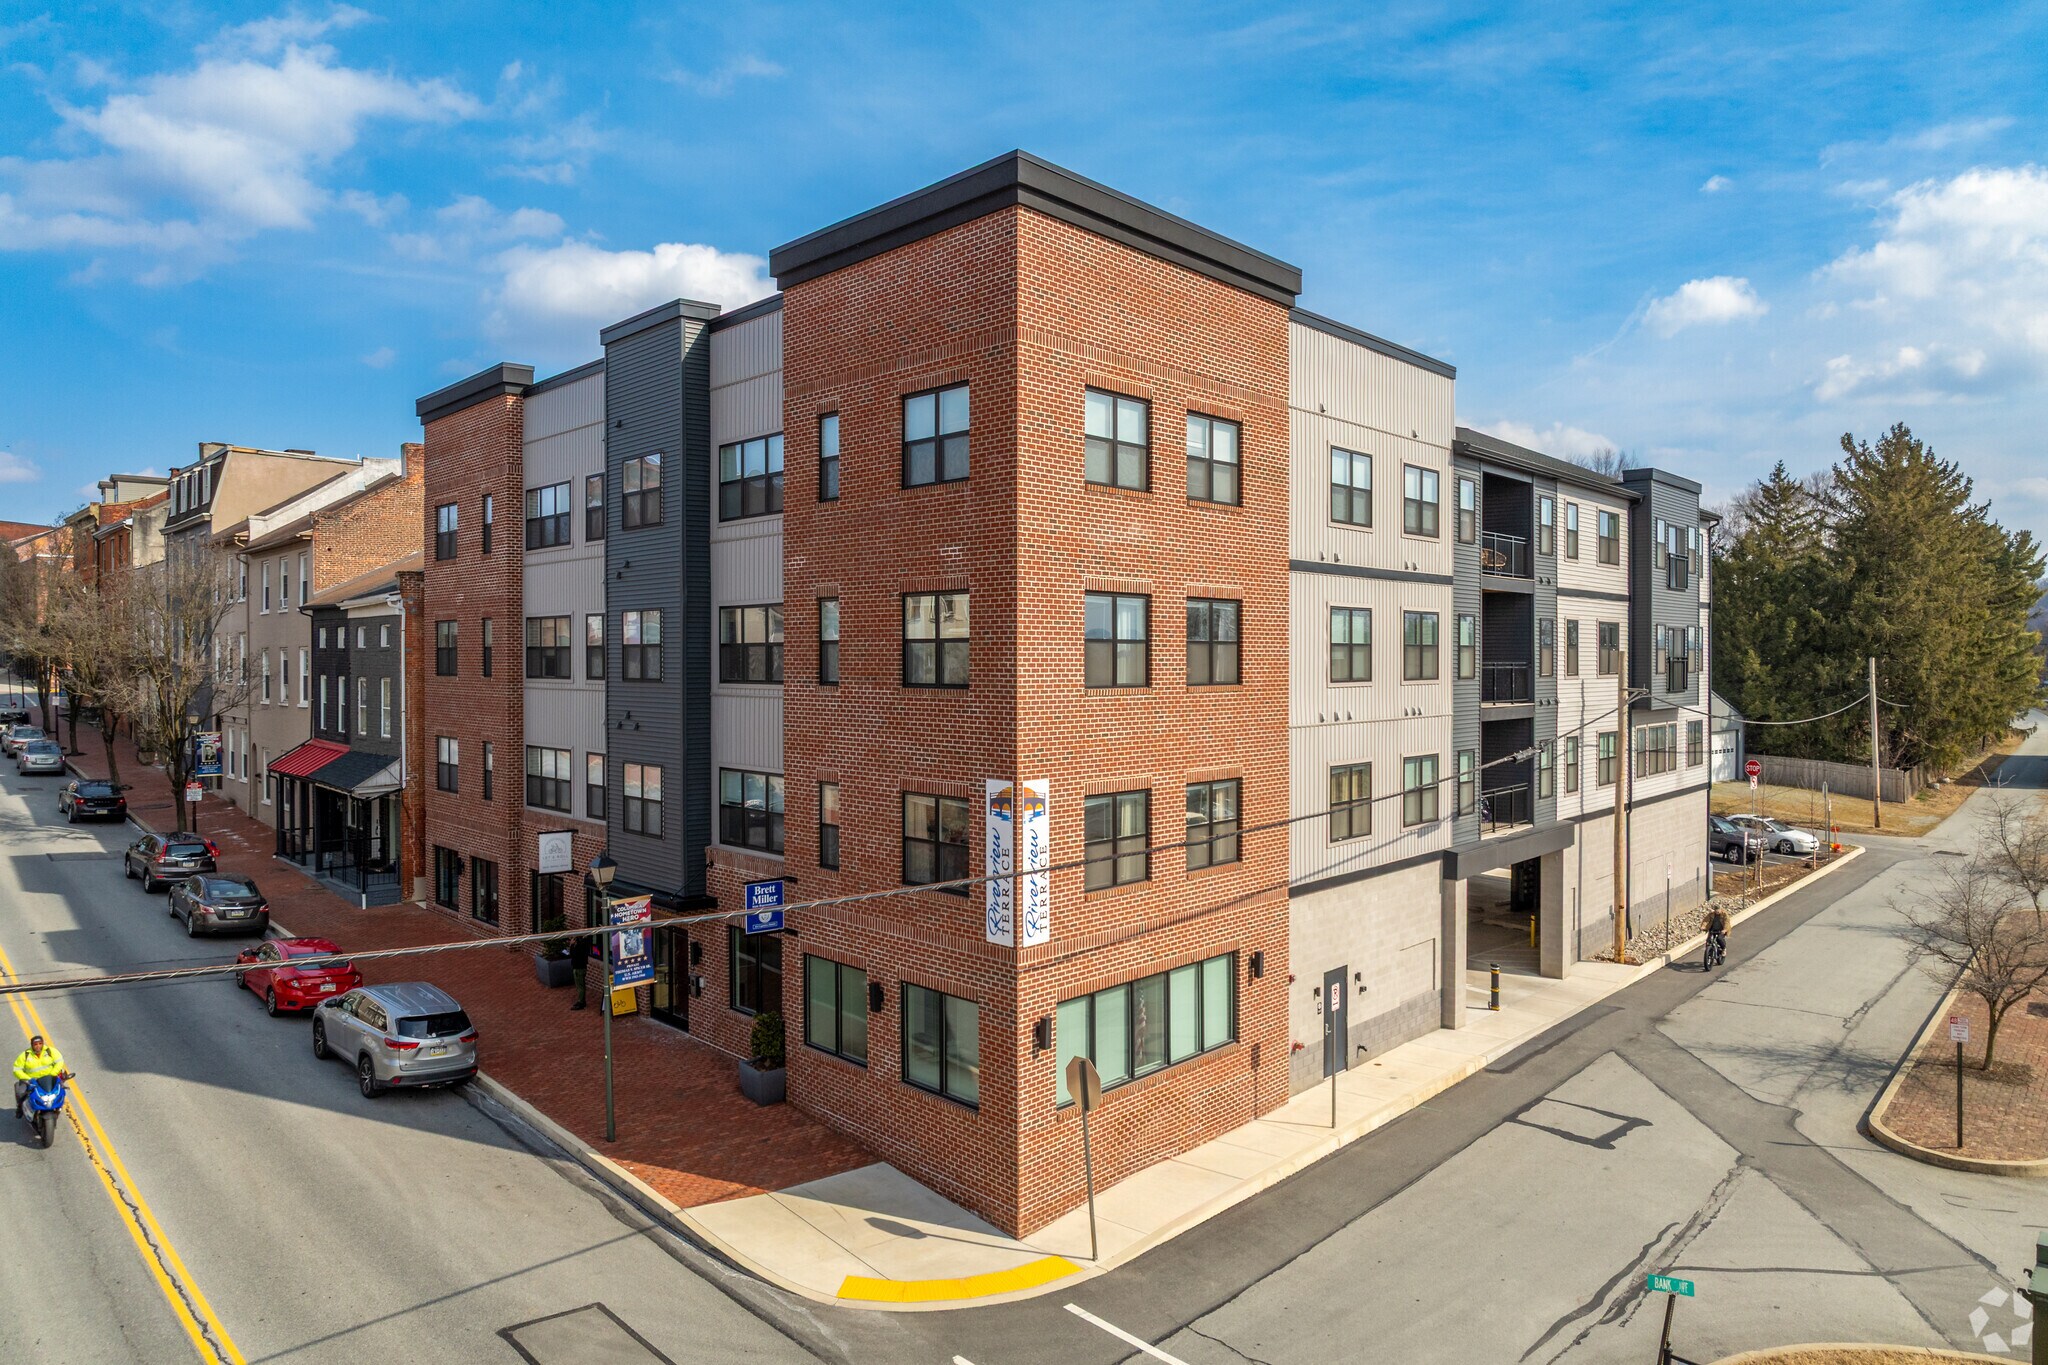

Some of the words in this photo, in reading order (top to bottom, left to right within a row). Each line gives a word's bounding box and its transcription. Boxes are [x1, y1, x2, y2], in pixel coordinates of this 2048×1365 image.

[988, 827, 1002, 936] Riverview
[1026, 829, 1040, 937] Riverview
[754, 885, 776, 895] Brett
[1002, 848, 1010, 935] TERRACE
[752, 894, 778, 905] Miller
[614, 908, 647, 918] HOMETOWN
[622, 914, 639, 922] HERO
[1654, 1277, 1672, 1291] BANK
